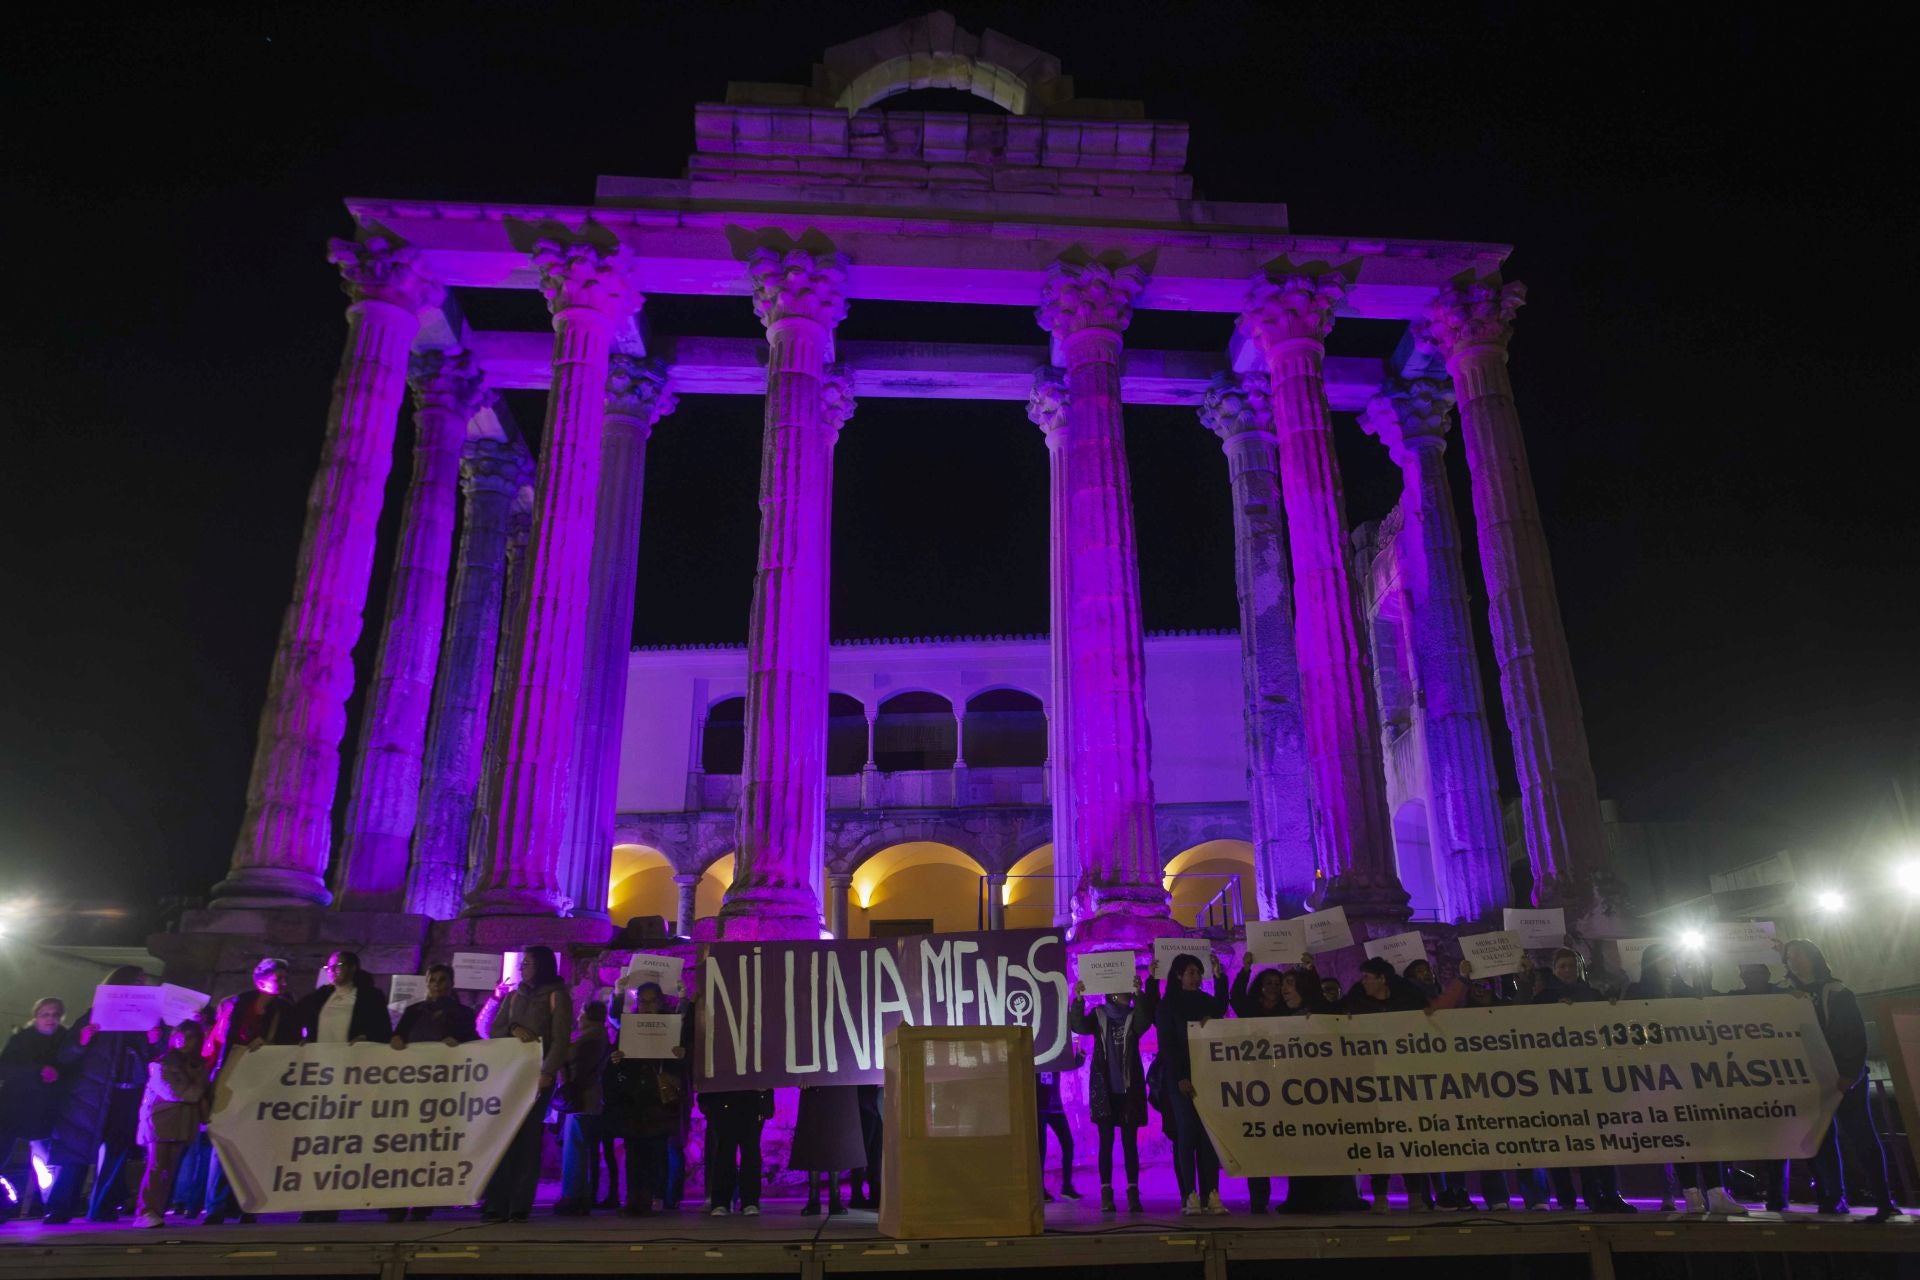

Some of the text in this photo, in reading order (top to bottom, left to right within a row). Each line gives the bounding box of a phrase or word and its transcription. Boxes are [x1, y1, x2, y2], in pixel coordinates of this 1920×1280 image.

[704, 933, 1068, 1078] NI UNA MENOS
[1340, 1036, 1387, 1056] han
[1396, 1033, 1447, 1054] sido
[280, 1058, 488, 1086] ¿Es necesario
[1221, 1052, 1810, 1107] NO CONSINTAMOS NI UNA MÁS!!!
[257, 1092, 501, 1123] recibir un golpe
[1242, 1100, 1796, 1137] 25 de noviembre. Día Internacional para la Eliminación
[291, 1126, 465, 1162] para sentir
[1347, 1132, 1690, 1159] de la Violencia contra las Mujeres.
[273, 1161, 472, 1191] la violencia?
